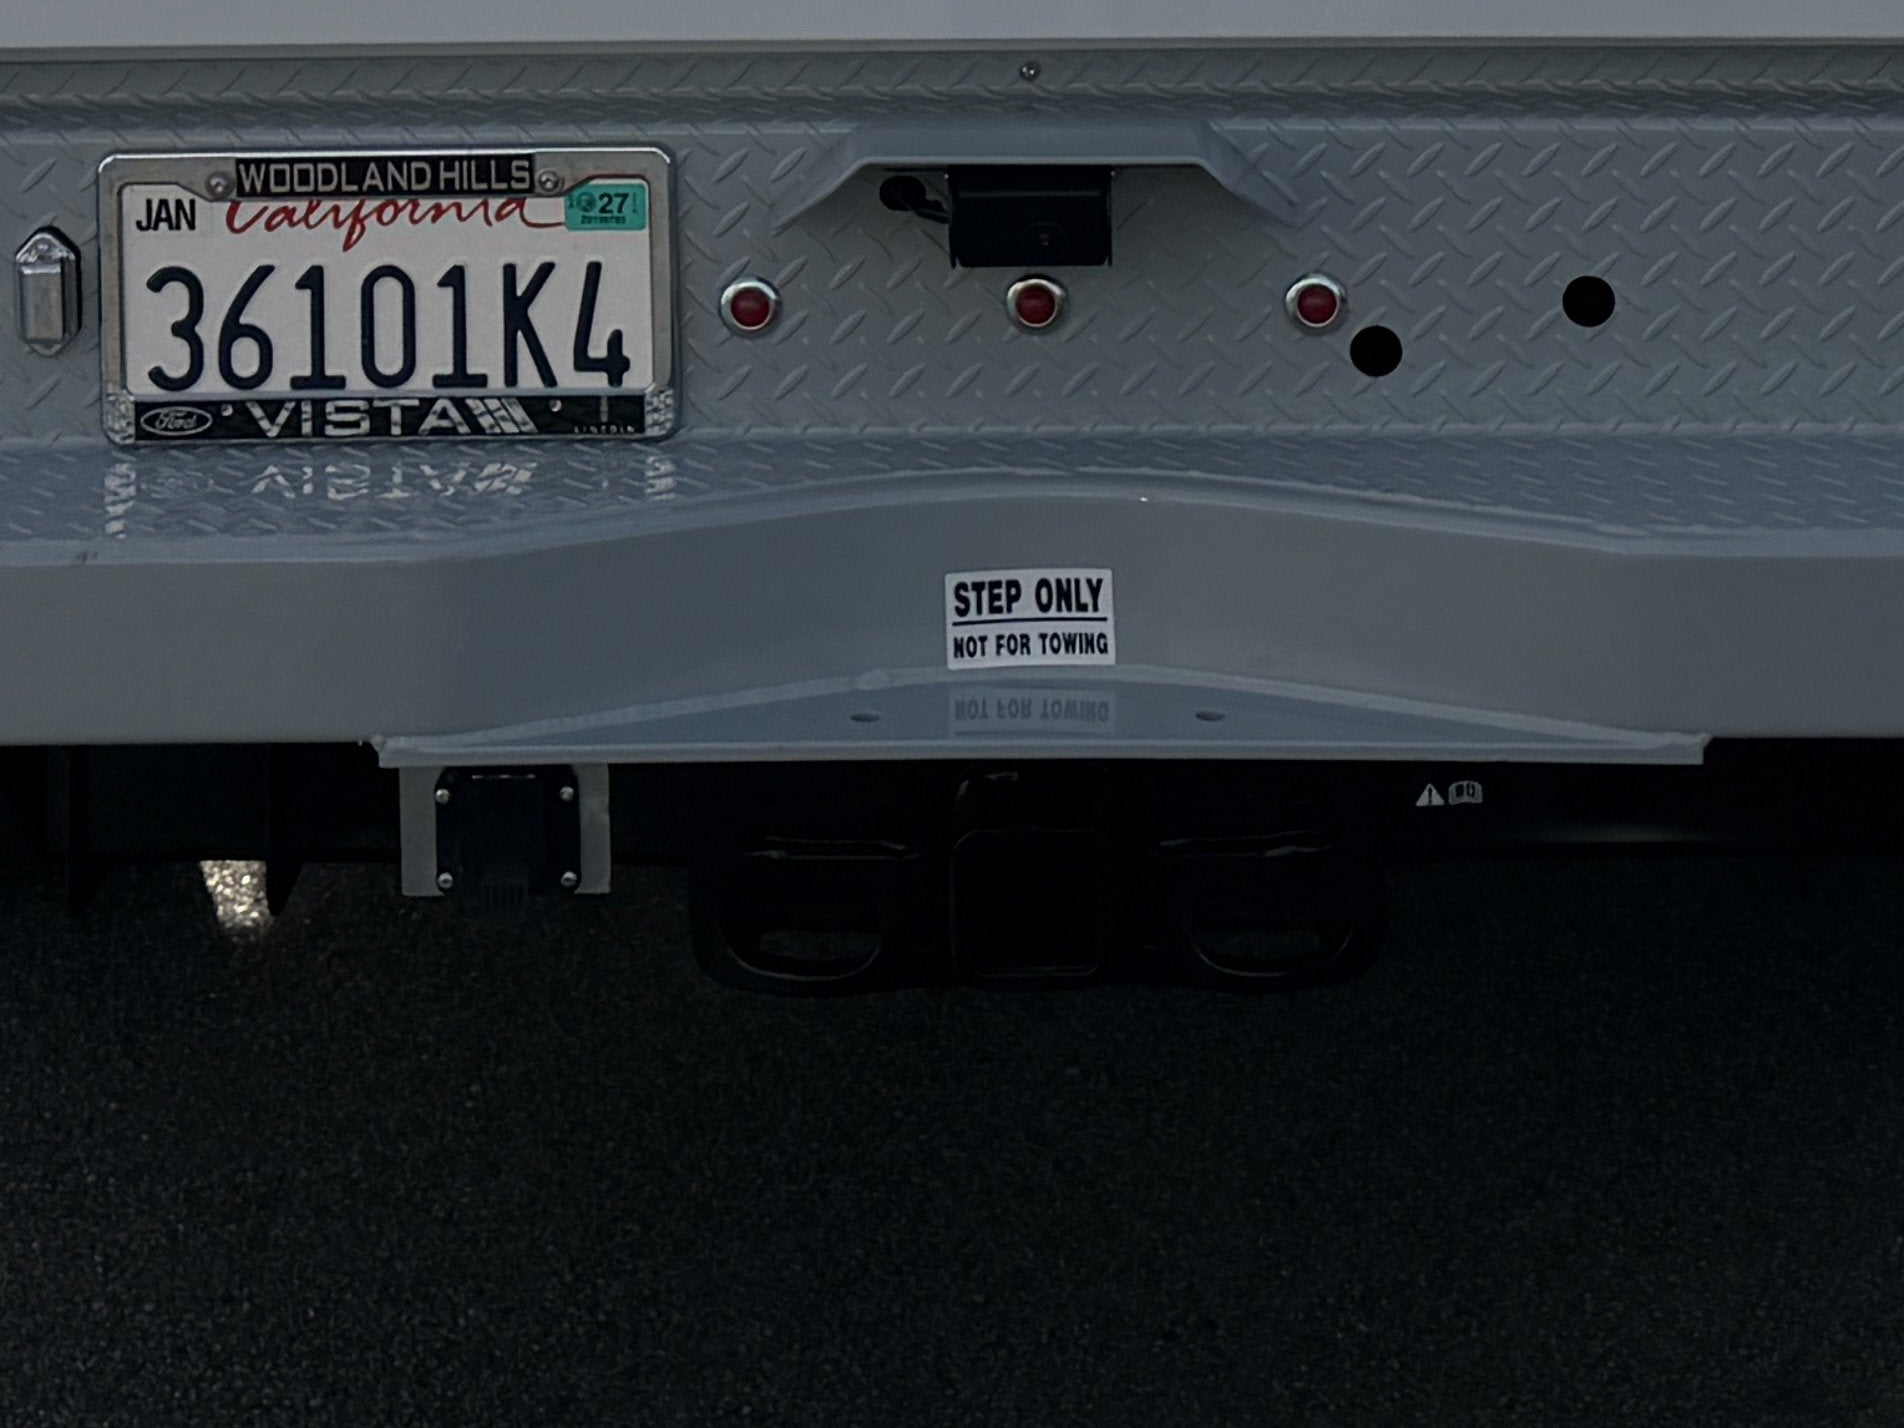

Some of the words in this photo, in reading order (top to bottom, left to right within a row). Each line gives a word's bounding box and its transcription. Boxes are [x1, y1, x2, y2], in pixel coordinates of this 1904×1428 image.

[239, 160, 432, 194] WOODLAND
[439, 159, 530, 191] HILLS
[135, 197, 197, 232] JAN
[598, 191, 630, 215] 27
[145, 260, 631, 392] 36101K4
[247, 399, 476, 438] VISTA
[953, 579, 1022, 617] STEP
[1035, 577, 1104, 613] ONLY
[953, 635, 988, 659] NOT
[996, 633, 1031, 656] FOR
[1039, 631, 1109, 655] TOWING
